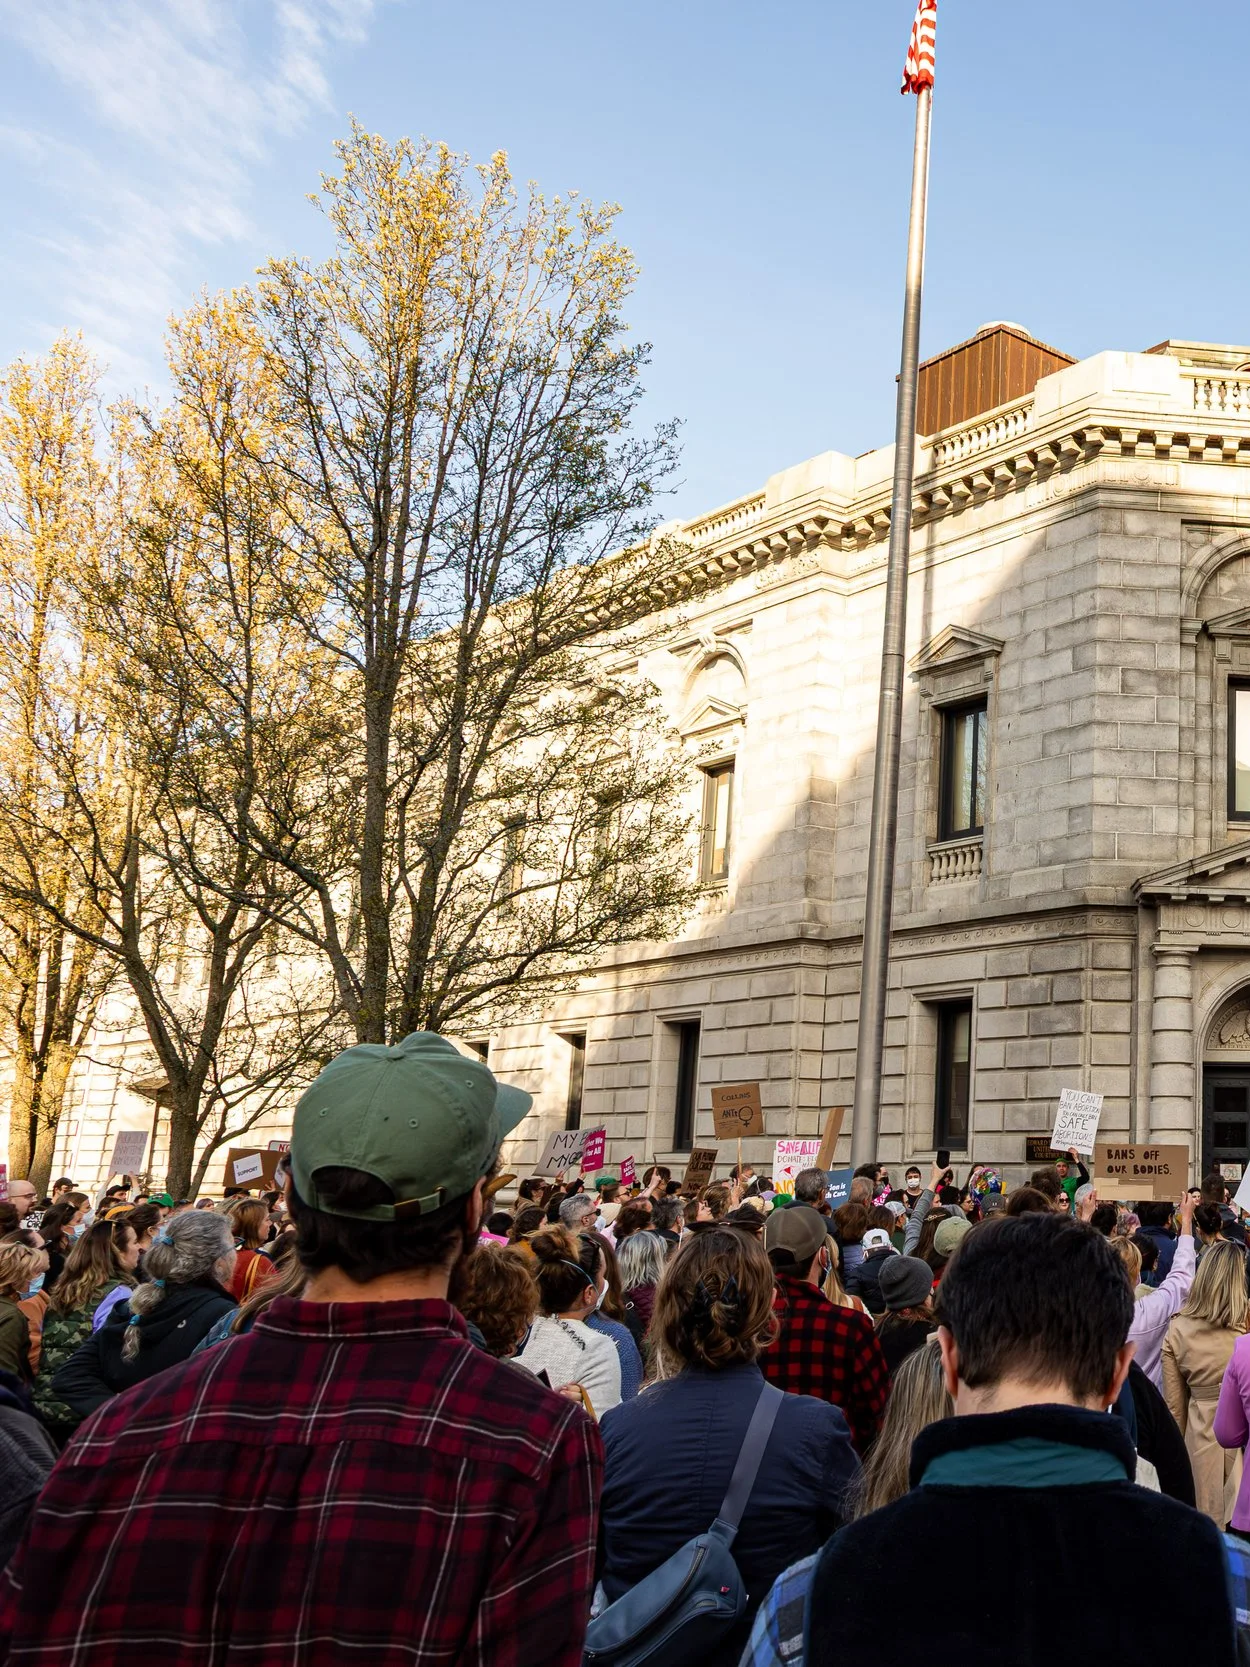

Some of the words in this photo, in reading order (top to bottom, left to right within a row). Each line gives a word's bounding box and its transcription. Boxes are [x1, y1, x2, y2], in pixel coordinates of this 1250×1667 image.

[1058, 1116, 1089, 1131] SAFE
[553, 1133, 578, 1150] MY
[778, 1140, 800, 1154] SAVE
[808, 1142, 821, 1155] LIF
[546, 1153, 569, 1169] MY
[1107, 1149, 1135, 1160] BANS
[1143, 1150, 1160, 1160] OFF
[237, 1165, 258, 1177] SUPPORT
[1107, 1165, 1127, 1174] OUR
[1133, 1163, 1172, 1176] BODIES.
